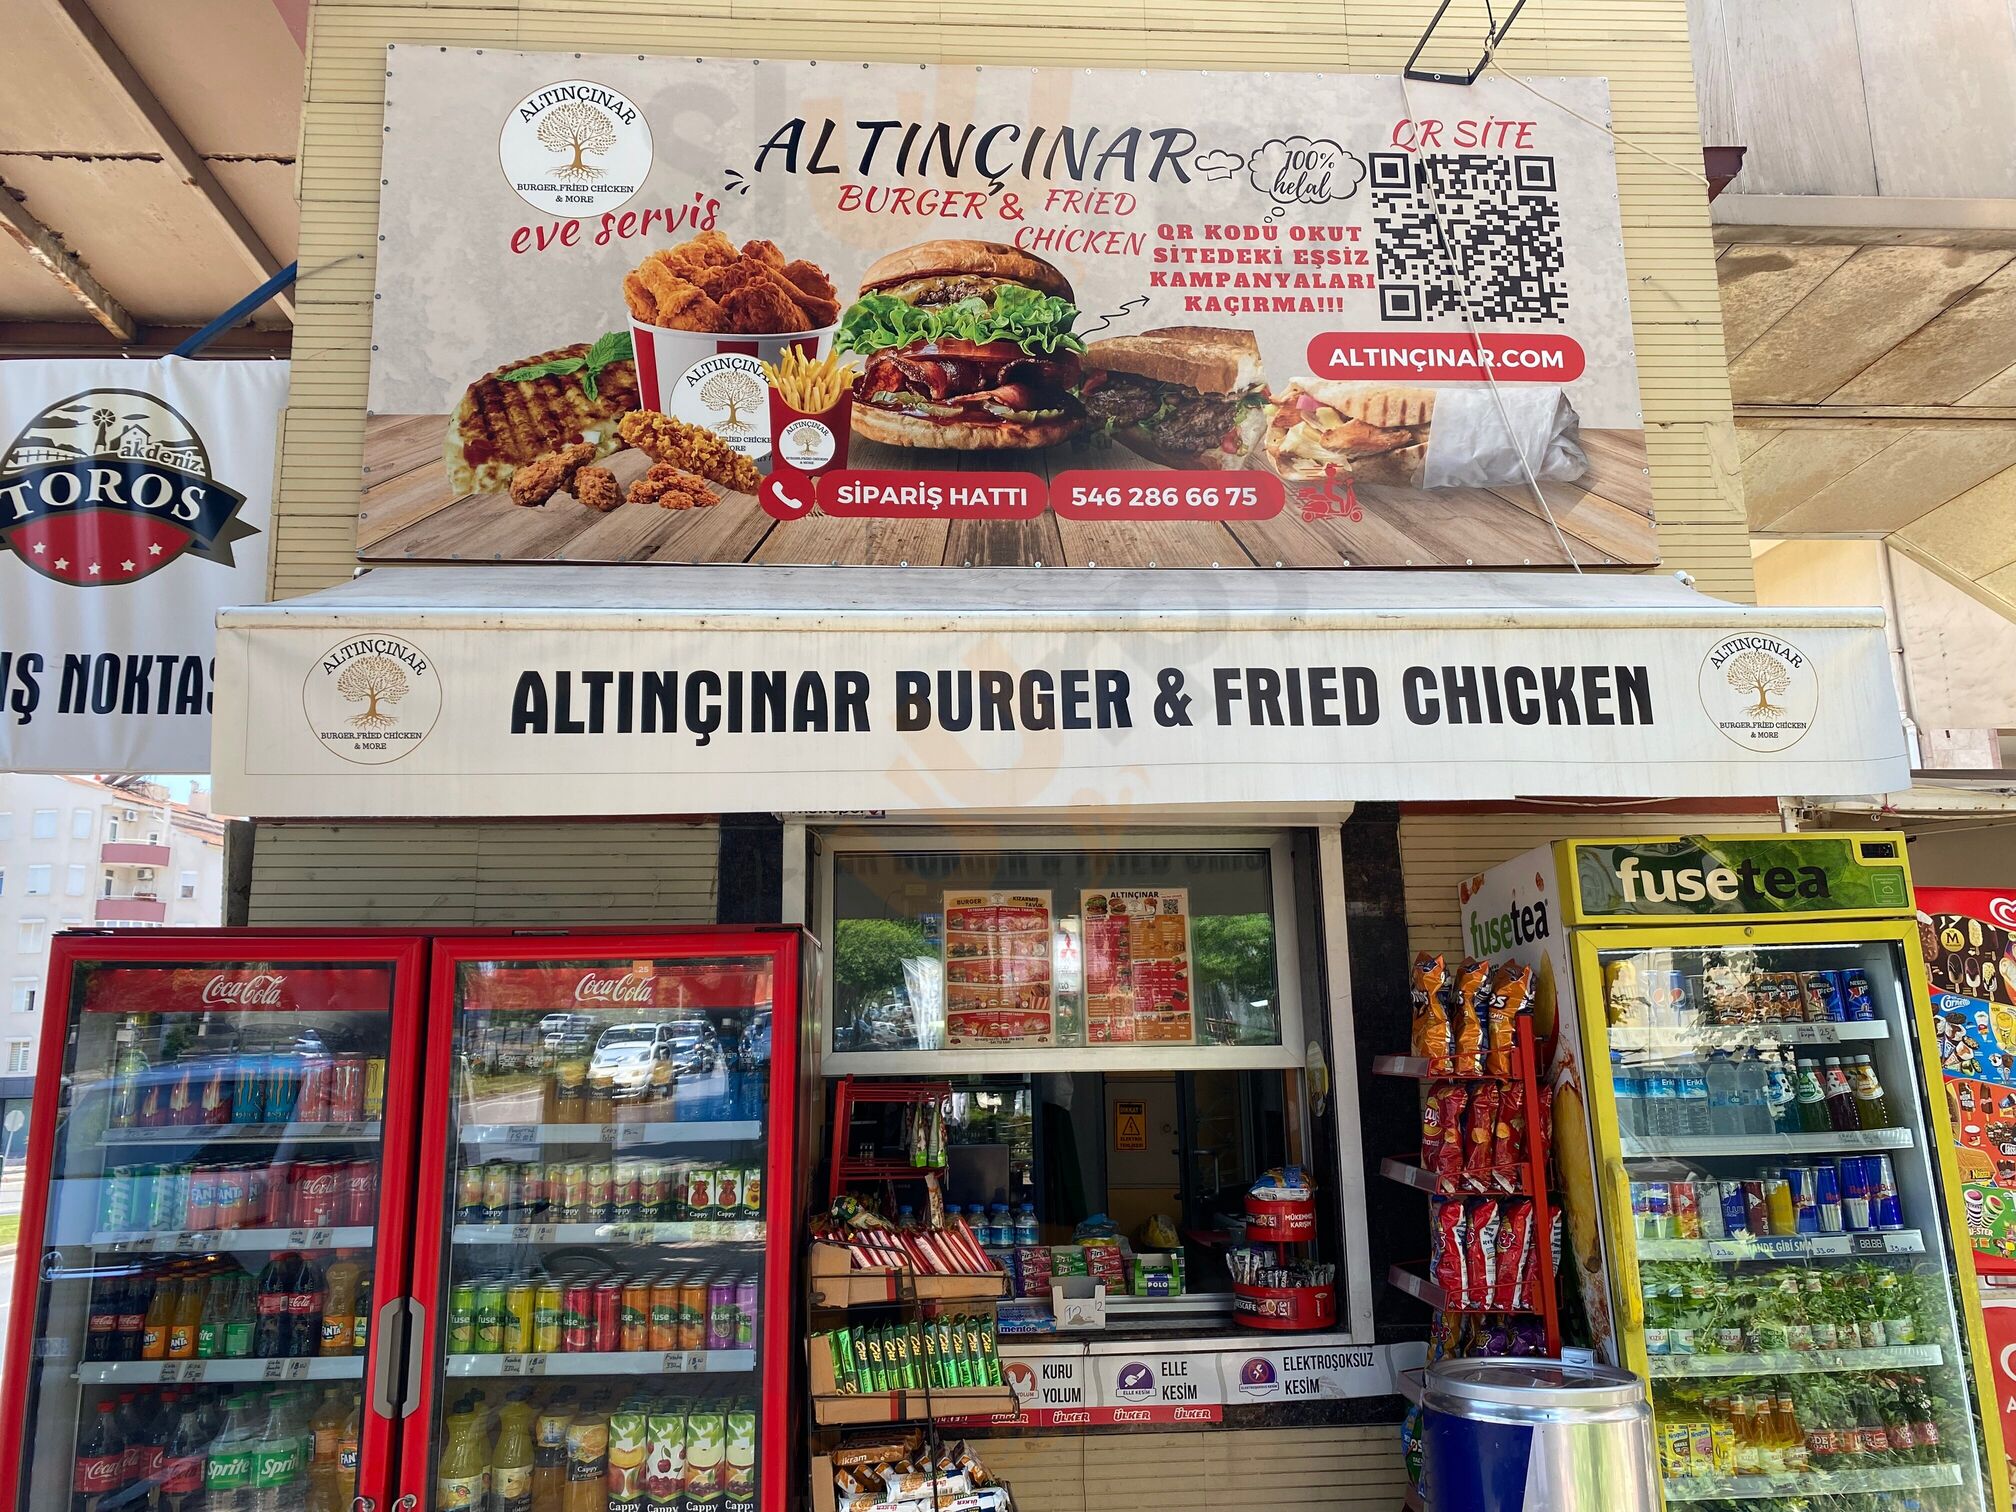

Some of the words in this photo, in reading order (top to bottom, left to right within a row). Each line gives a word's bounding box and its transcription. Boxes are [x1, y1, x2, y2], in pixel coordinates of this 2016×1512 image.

[519, 85, 637, 126] ALTINÇINAR
[1391, 120, 1450, 150] QR
[1454, 115, 1537, 149] SİTE
[754, 116, 1199, 197] ALTINÇINAR
[1273, 167, 1332, 200] helal
[555, 195, 563, 203] &
[564, 195, 594, 204] MORE
[837, 184, 993, 220] BURGER
[999, 192, 1026, 221] &
[1044, 183, 1137, 218] FRİED
[510, 218, 581, 255] eve
[594, 190, 722, 247] servis
[1156, 224, 1198, 243] QR
[1204, 224, 1279, 243] KODU
[1289, 225, 1362, 243] OKUT
[1012, 222, 1149, 257] CHİCKEN
[1153, 243, 1282, 266] SİTEDEKİ
[1292, 243, 1370, 270] EŞSİZ
[1149, 271, 1376, 290] KAMPANYALARI
[1184, 295, 1345, 317] KAÇIRMA!!!
[685, 357, 771, 388] ALTINÇINA
[1327, 346, 1564, 374] ALTINÇINAR.COM
[727, 444, 746, 452] ORE
[742, 435, 771, 445] CHİCKE
[119, 440, 202, 473] akdeniz
[1, 467, 207, 521] TOROS
[836, 479, 945, 511] SİPARİŞ
[947, 487, 1029, 507] HATTI
[1070, 486, 1124, 508] 546
[1128, 486, 1179, 508] 286
[1183, 486, 1220, 508] 66
[1224, 486, 1258, 508] 75
[321, 638, 427, 677] ALTINÇINAR
[1709, 635, 1804, 672] ALTINÇINAR
[57, 652, 215, 716] NOKTA
[510, 669, 871, 747] ALTINÇINAR
[895, 667, 1130, 733] BURGER
[1152, 666, 1192, 728] &
[1214, 666, 1382, 728] FRIED
[1403, 664, 1655, 727] CHICKEN
[353, 742, 361, 750] &
[362, 742, 387, 750] MORE
[1757, 731, 1779, 739] MORE
[956, 898, 982, 906] BURGER
[1110, 891, 1160, 900] ALTINÇINAR
[1946, 932, 1960, 944] M
[201, 974, 288, 1007] Coca-Cola
[574, 972, 656, 1003] Coca-Cola
[482, 1208, 503, 1218] Cappy
[689, 1211, 709, 1219] Cappy
[716, 1210, 737, 1219] Cappy
[743, 1209, 760, 1218] Capp
[478, 1313, 496, 1325] fuse
[535, 1313, 551, 1325] fuse
[620, 1313, 634, 1323] use
[651, 1311, 670, 1321] fuse
[679, 1313, 691, 1322] use
[711, 1311, 730, 1322] fuse
[1000, 1325, 1038, 1333] mentos
[1042, 1363, 1073, 1380] KURU
[1161, 1360, 1188, 1377] ELLE
[1282, 1351, 1375, 1373] ELEKTROŞOKSUZ
[1042, 1386, 1082, 1404] YOLUM
[1162, 1384, 1198, 1401] KESİM
[1284, 1377, 1321, 1396] KESİM
[1053, 1410, 1090, 1424] ÜLKER
[1113, 1408, 1151, 1422] ÜLKER
[1173, 1406, 1211, 1420] ÜLKER
[207, 1458, 249, 1480] Sprite
[261, 1454, 299, 1476] Sprit
[577, 1465, 599, 1474] Cappy
[841, 1453, 868, 1465] ikram
[608, 1501, 641, 1512] Cappy
[686, 1501, 719, 1512] Cappy
